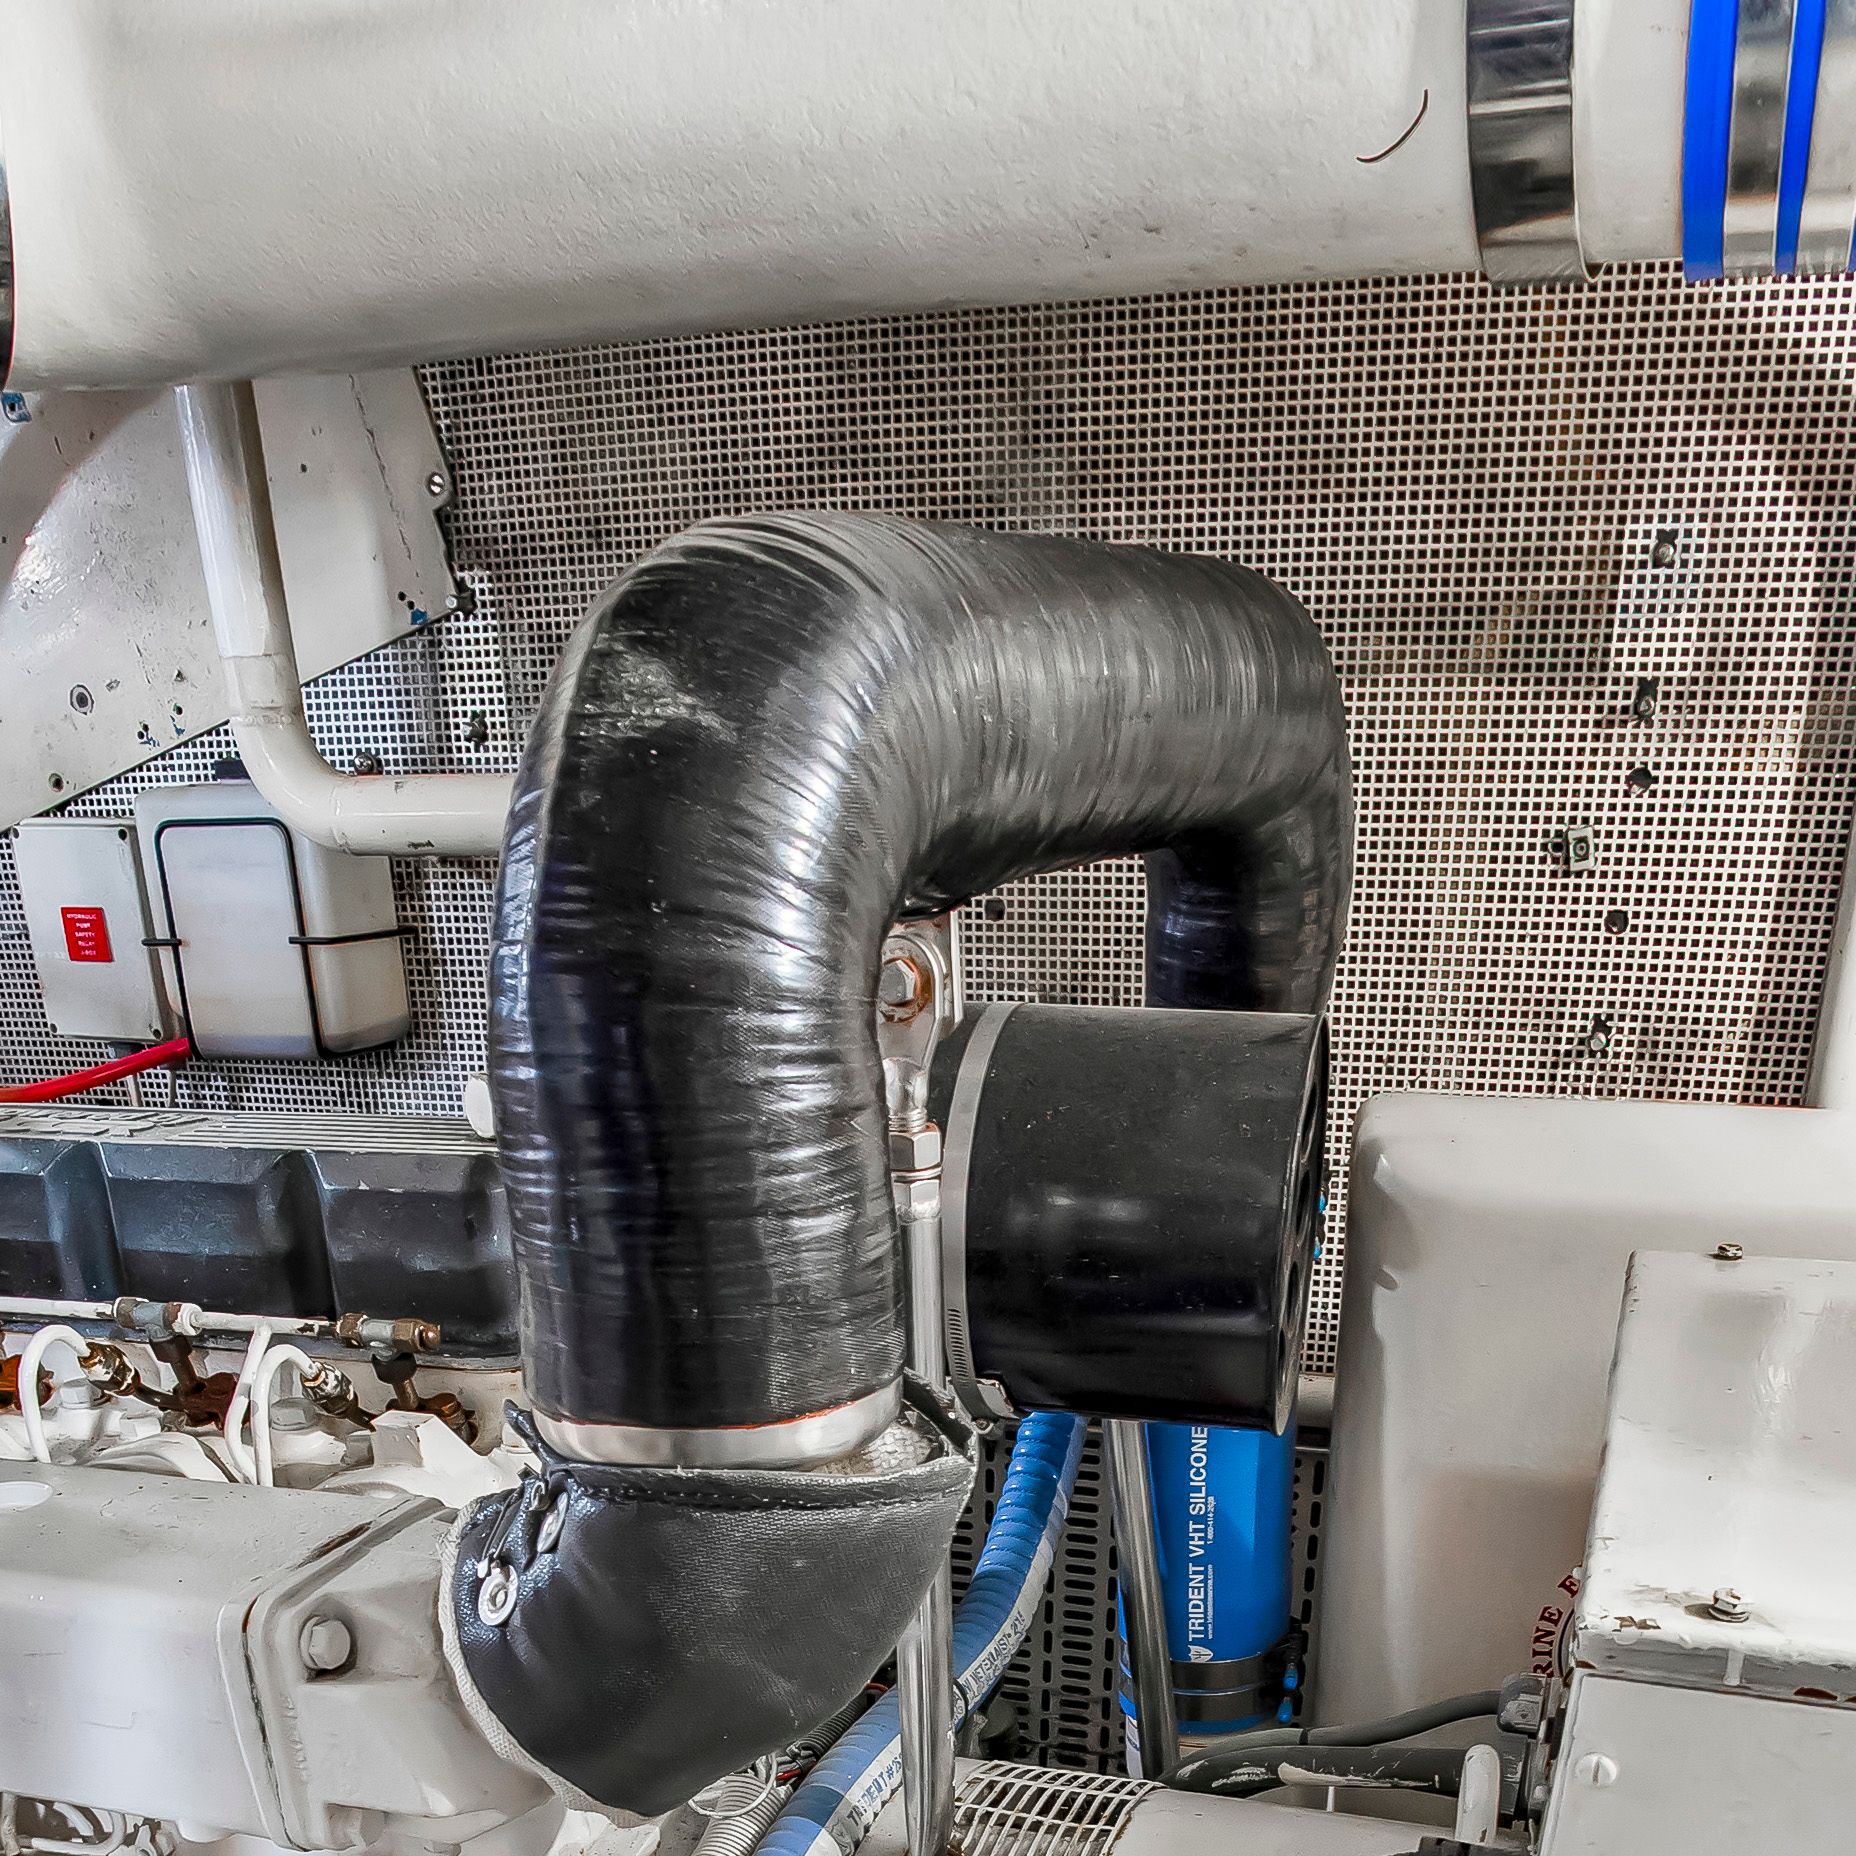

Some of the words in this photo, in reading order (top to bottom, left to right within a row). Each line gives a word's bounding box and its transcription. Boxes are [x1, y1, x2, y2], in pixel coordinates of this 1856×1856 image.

[1189, 1426, 1209, 1516] SILICONE
[1188, 1520, 1206, 1558] VHT
[1188, 1563, 1205, 1642] TRIDENT
